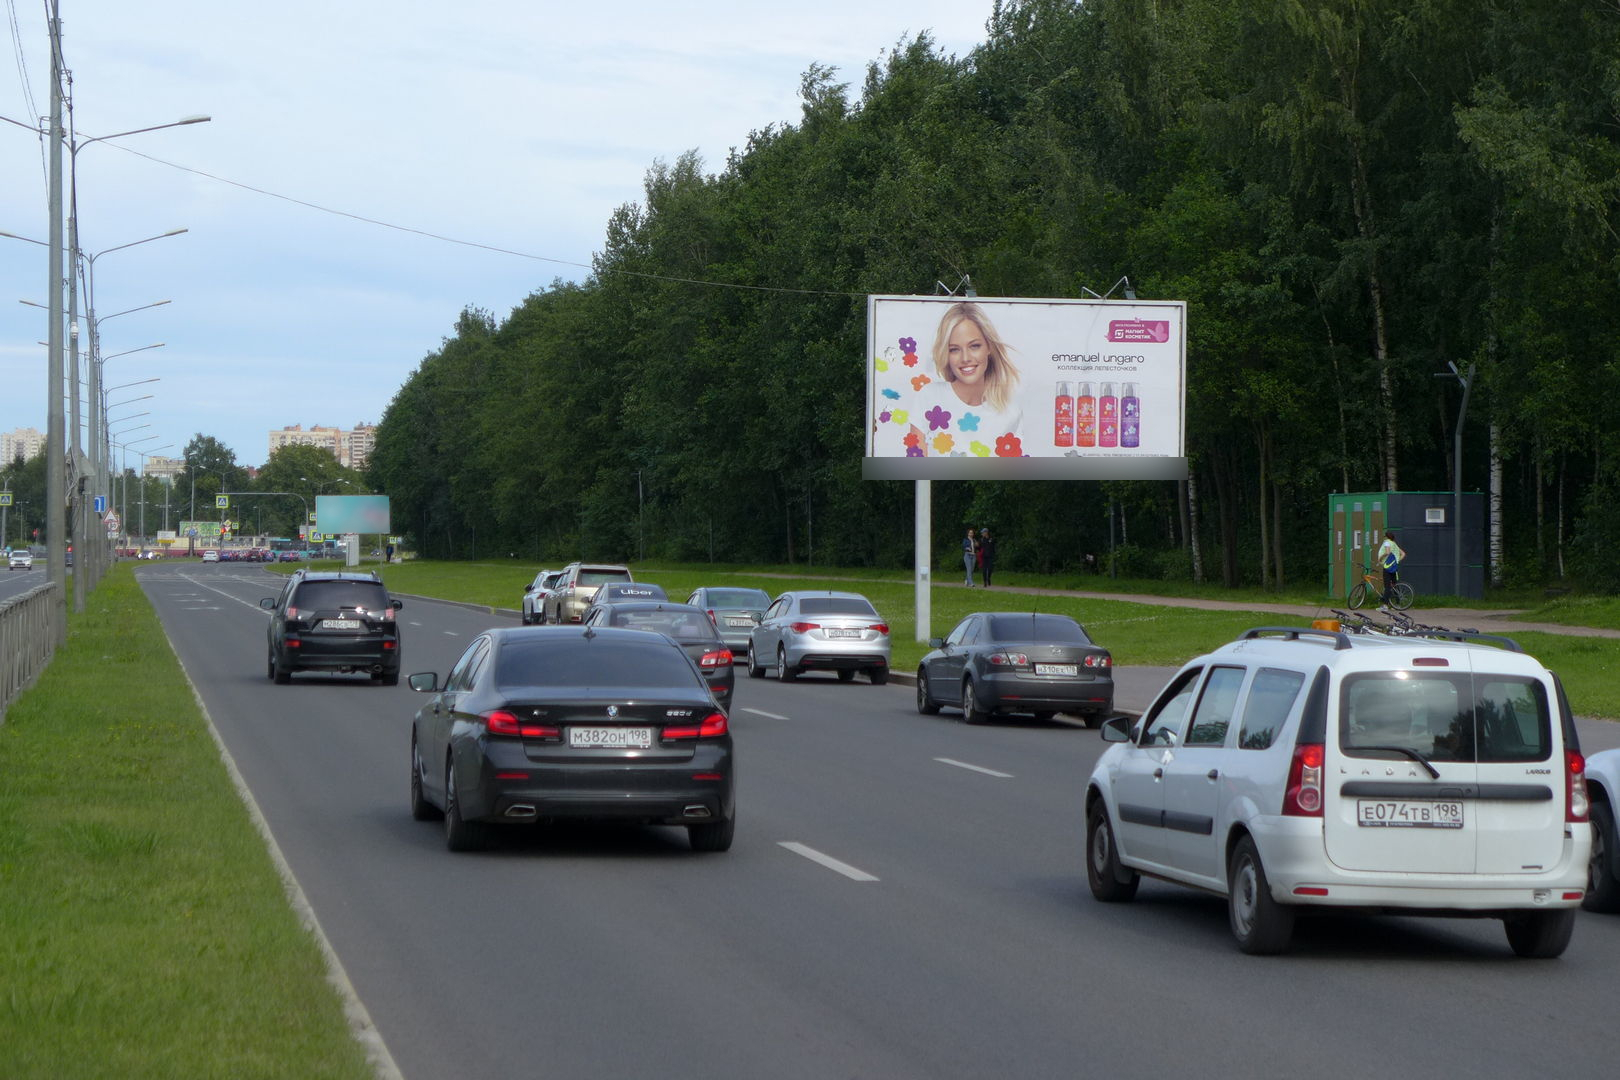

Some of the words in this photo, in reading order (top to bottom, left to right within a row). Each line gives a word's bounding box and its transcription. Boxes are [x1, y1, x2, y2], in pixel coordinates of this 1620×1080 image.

[1051, 352, 1100, 363] emanuel
[1103, 354, 1145, 365] ungaro
[1340, 766, 1417, 777] LADA
